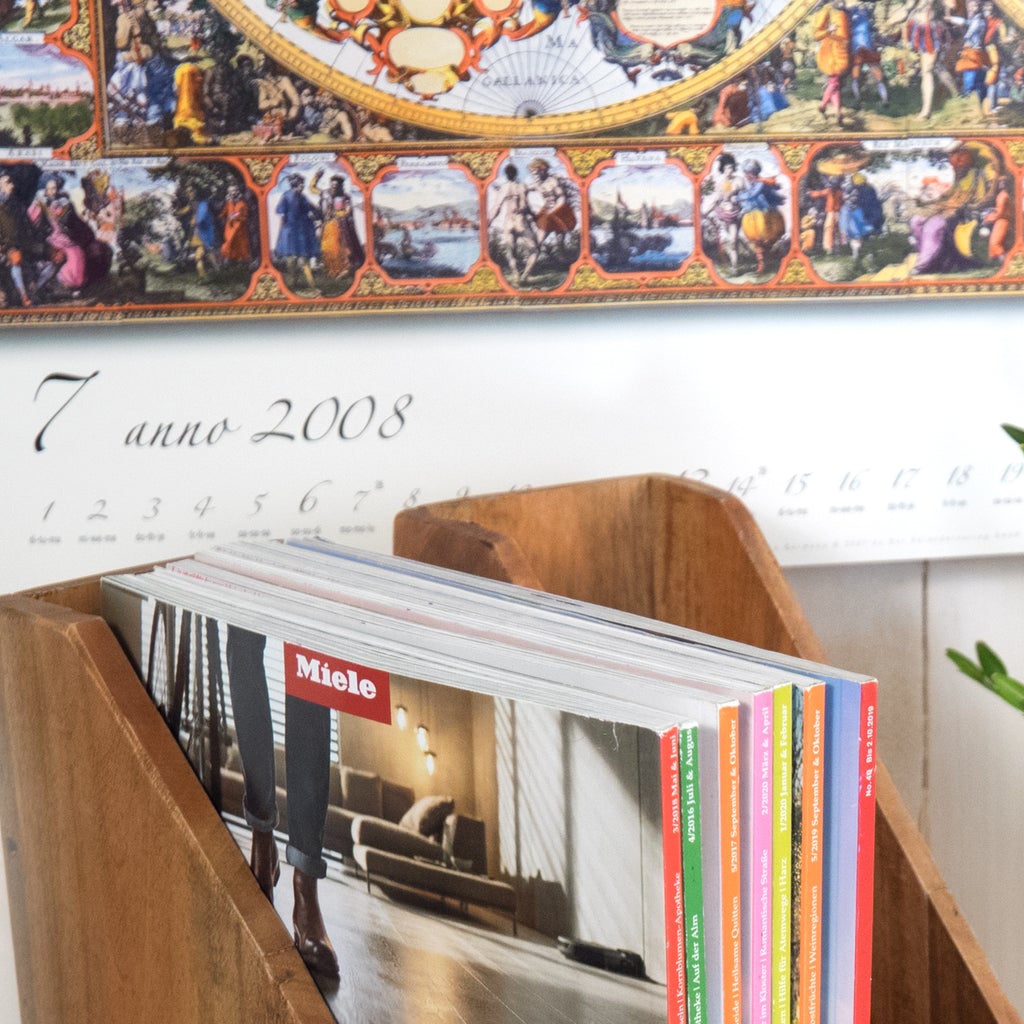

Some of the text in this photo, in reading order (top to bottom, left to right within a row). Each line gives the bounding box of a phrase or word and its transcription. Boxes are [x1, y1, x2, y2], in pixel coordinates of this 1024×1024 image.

[33, 370, 413, 452] 7 anno 2008
[42, 500, 55, 521] 1
[85, 498, 108, 521] 2
[142, 497, 162, 521] 3
[194, 495, 216, 518] 4
[247, 491, 270, 517] 5
[298, 479, 333, 514] 6
[784, 471, 813, 495] 15
[891, 467, 921, 490] 17
[945, 464, 974, 487] 18
[295, 652, 378, 700] Miele
[729, 719, 737, 765] Oktober
[762, 706, 771, 735] April
[670, 734, 679, 760] Juni
[780, 704, 789, 832] 1/2020 Januar Februar
[683, 728, 697, 843] 4/2016 Juli Augus
[730, 779, 740, 838] September
[761, 781, 770, 816] 2/2020
[811, 709, 822, 863] 5/2019 September Oktober
[760, 848, 769, 885] Straße
[779, 857, 788, 886] Harz
[673, 872, 686, 997] Kornblumen-Apotheke
[731, 896, 741, 939] Quitten
[760, 887, 769, 956] Romantische
[779, 894, 789, 953] Atemwege
[809, 885, 820, 964] Weinregionen
[732, 940, 740, 992] Heilsame
[759, 963, 768, 1002] Kloster
[779, 975, 787, 1002] Hilfe
